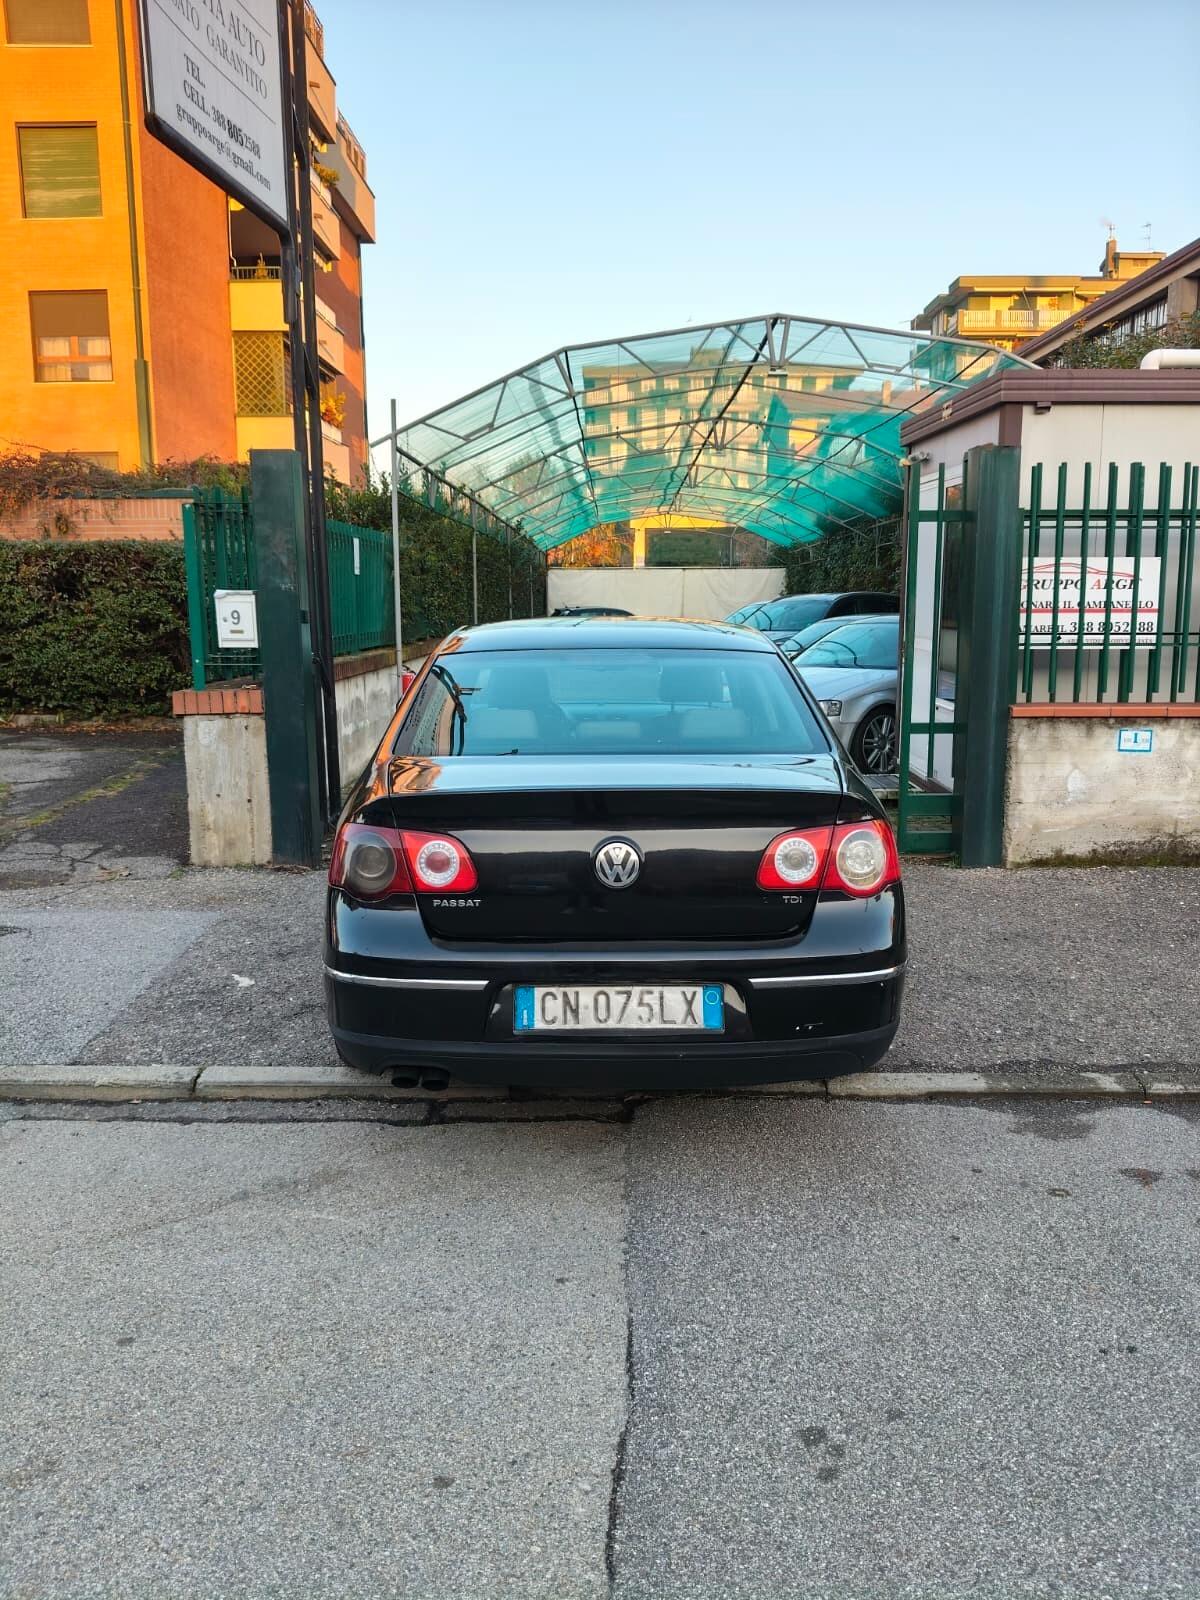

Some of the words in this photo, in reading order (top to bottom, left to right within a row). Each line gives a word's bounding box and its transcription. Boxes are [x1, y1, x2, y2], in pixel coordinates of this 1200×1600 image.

[171, 0, 200, 31] ATO
[206, 24, 267, 99] GARANTITO
[228, 10, 265, 66] AUTO
[183, 53, 206, 88] TEL.
[183, 80, 211, 117] CELL.
[1063, 600, 1075, 609] IL
[231, 610, 240, 625] 9
[1070, 622, 1094, 633] 38
[1098, 622, 1154, 633] 85288
[432, 899, 481, 907] PASSAT
